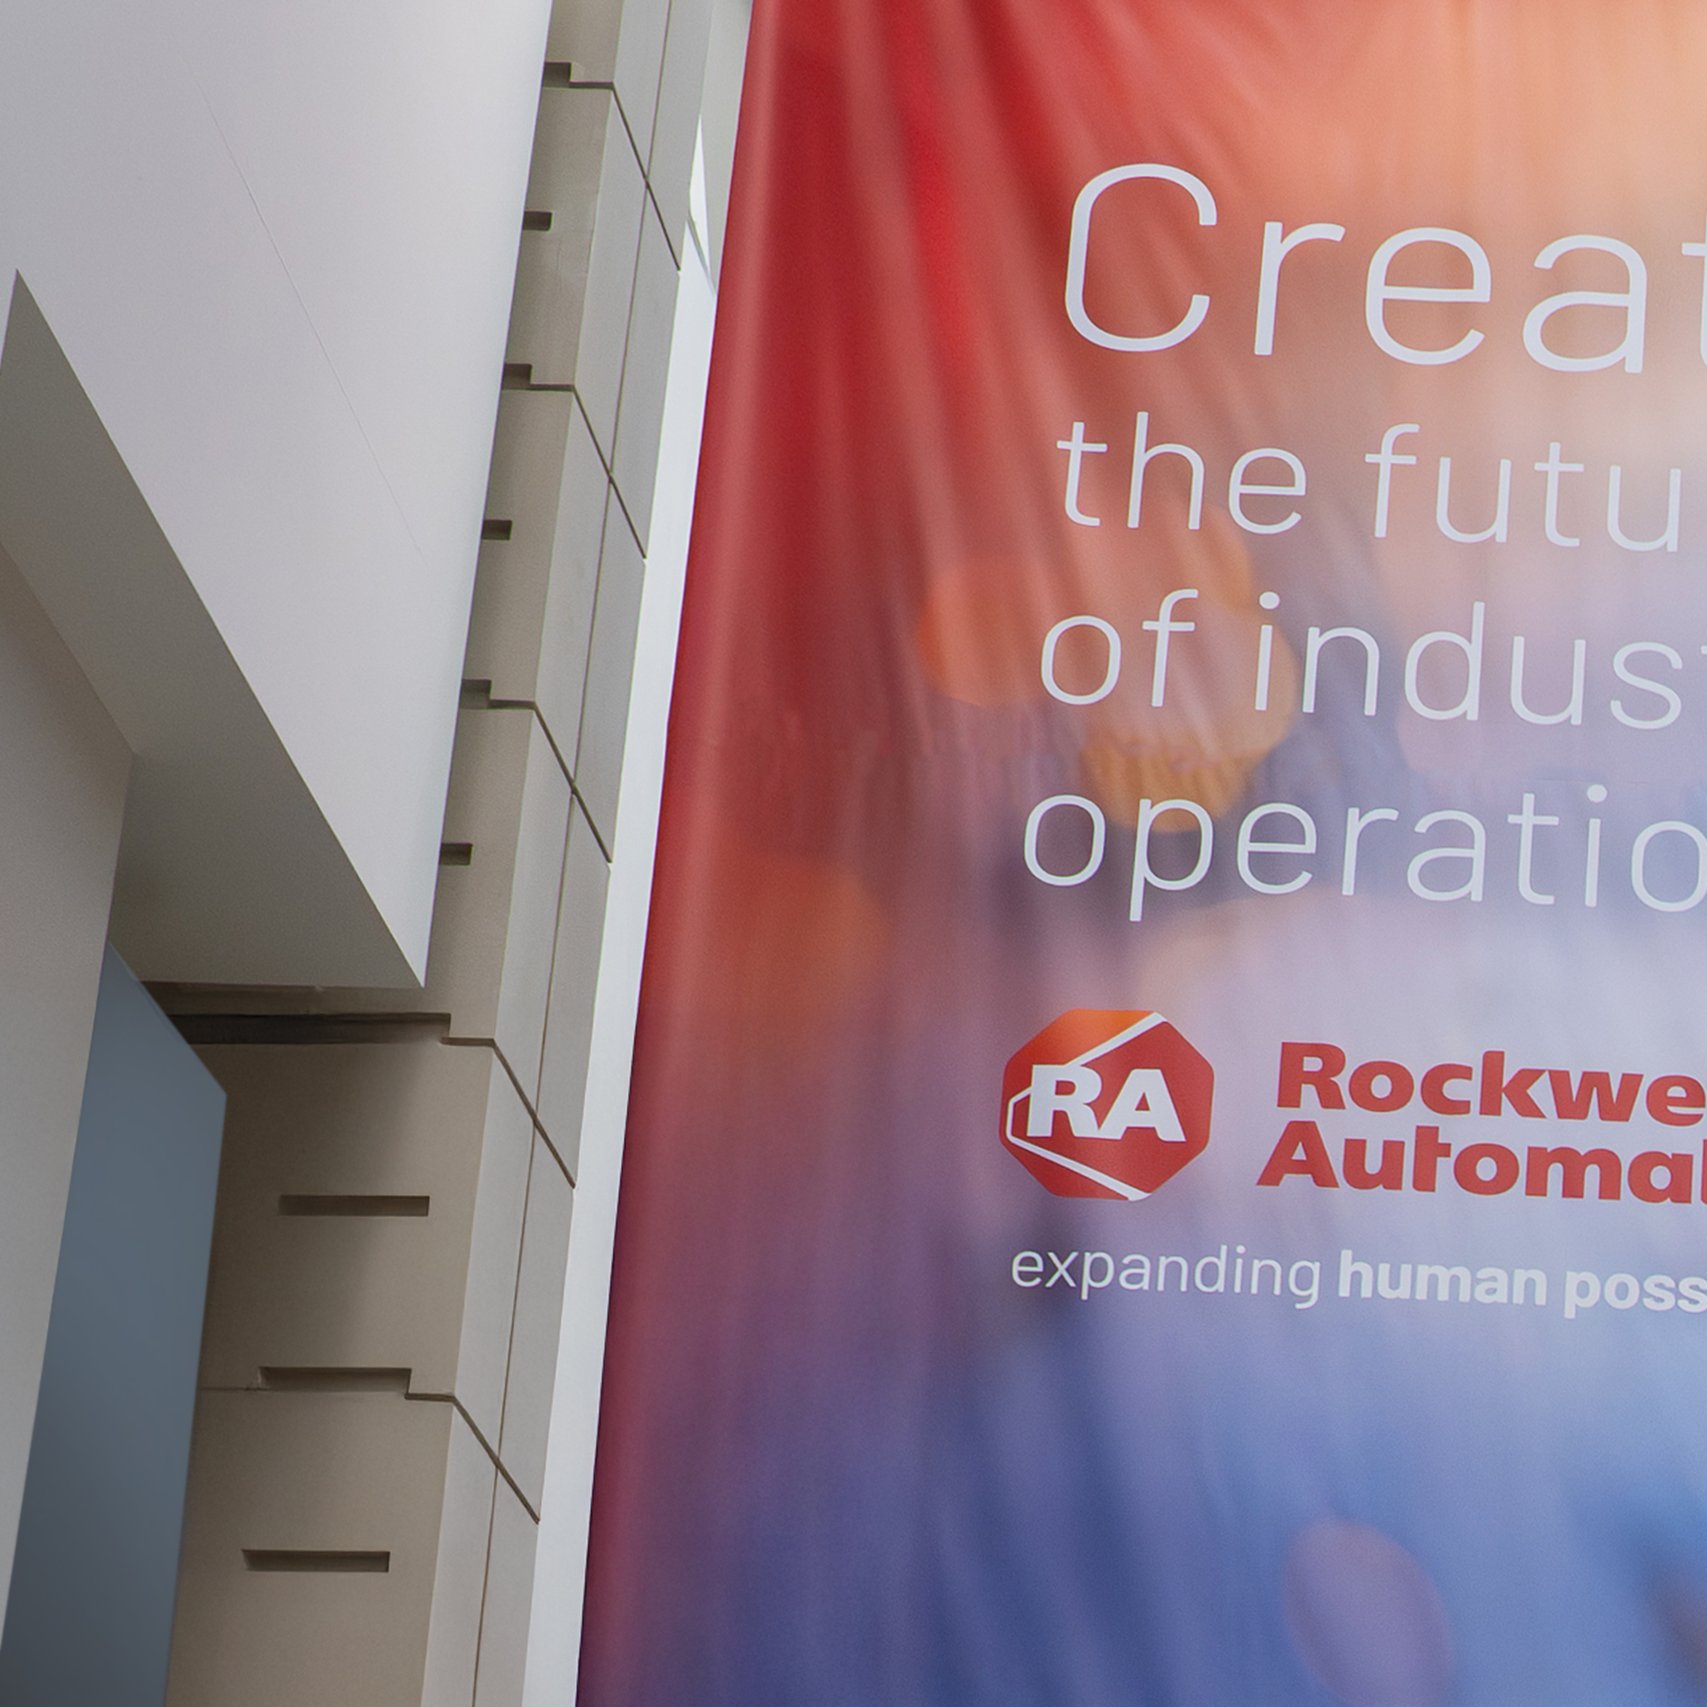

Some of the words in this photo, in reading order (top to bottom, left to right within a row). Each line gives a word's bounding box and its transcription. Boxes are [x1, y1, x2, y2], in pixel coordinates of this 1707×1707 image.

[1055, 411, 1308, 535] the
[1039, 589, 1198, 708] of
[1026, 1063, 1187, 1142] RA
[1010, 1245, 1320, 1309] expanding
[1338, 1250, 1547, 1307] human
